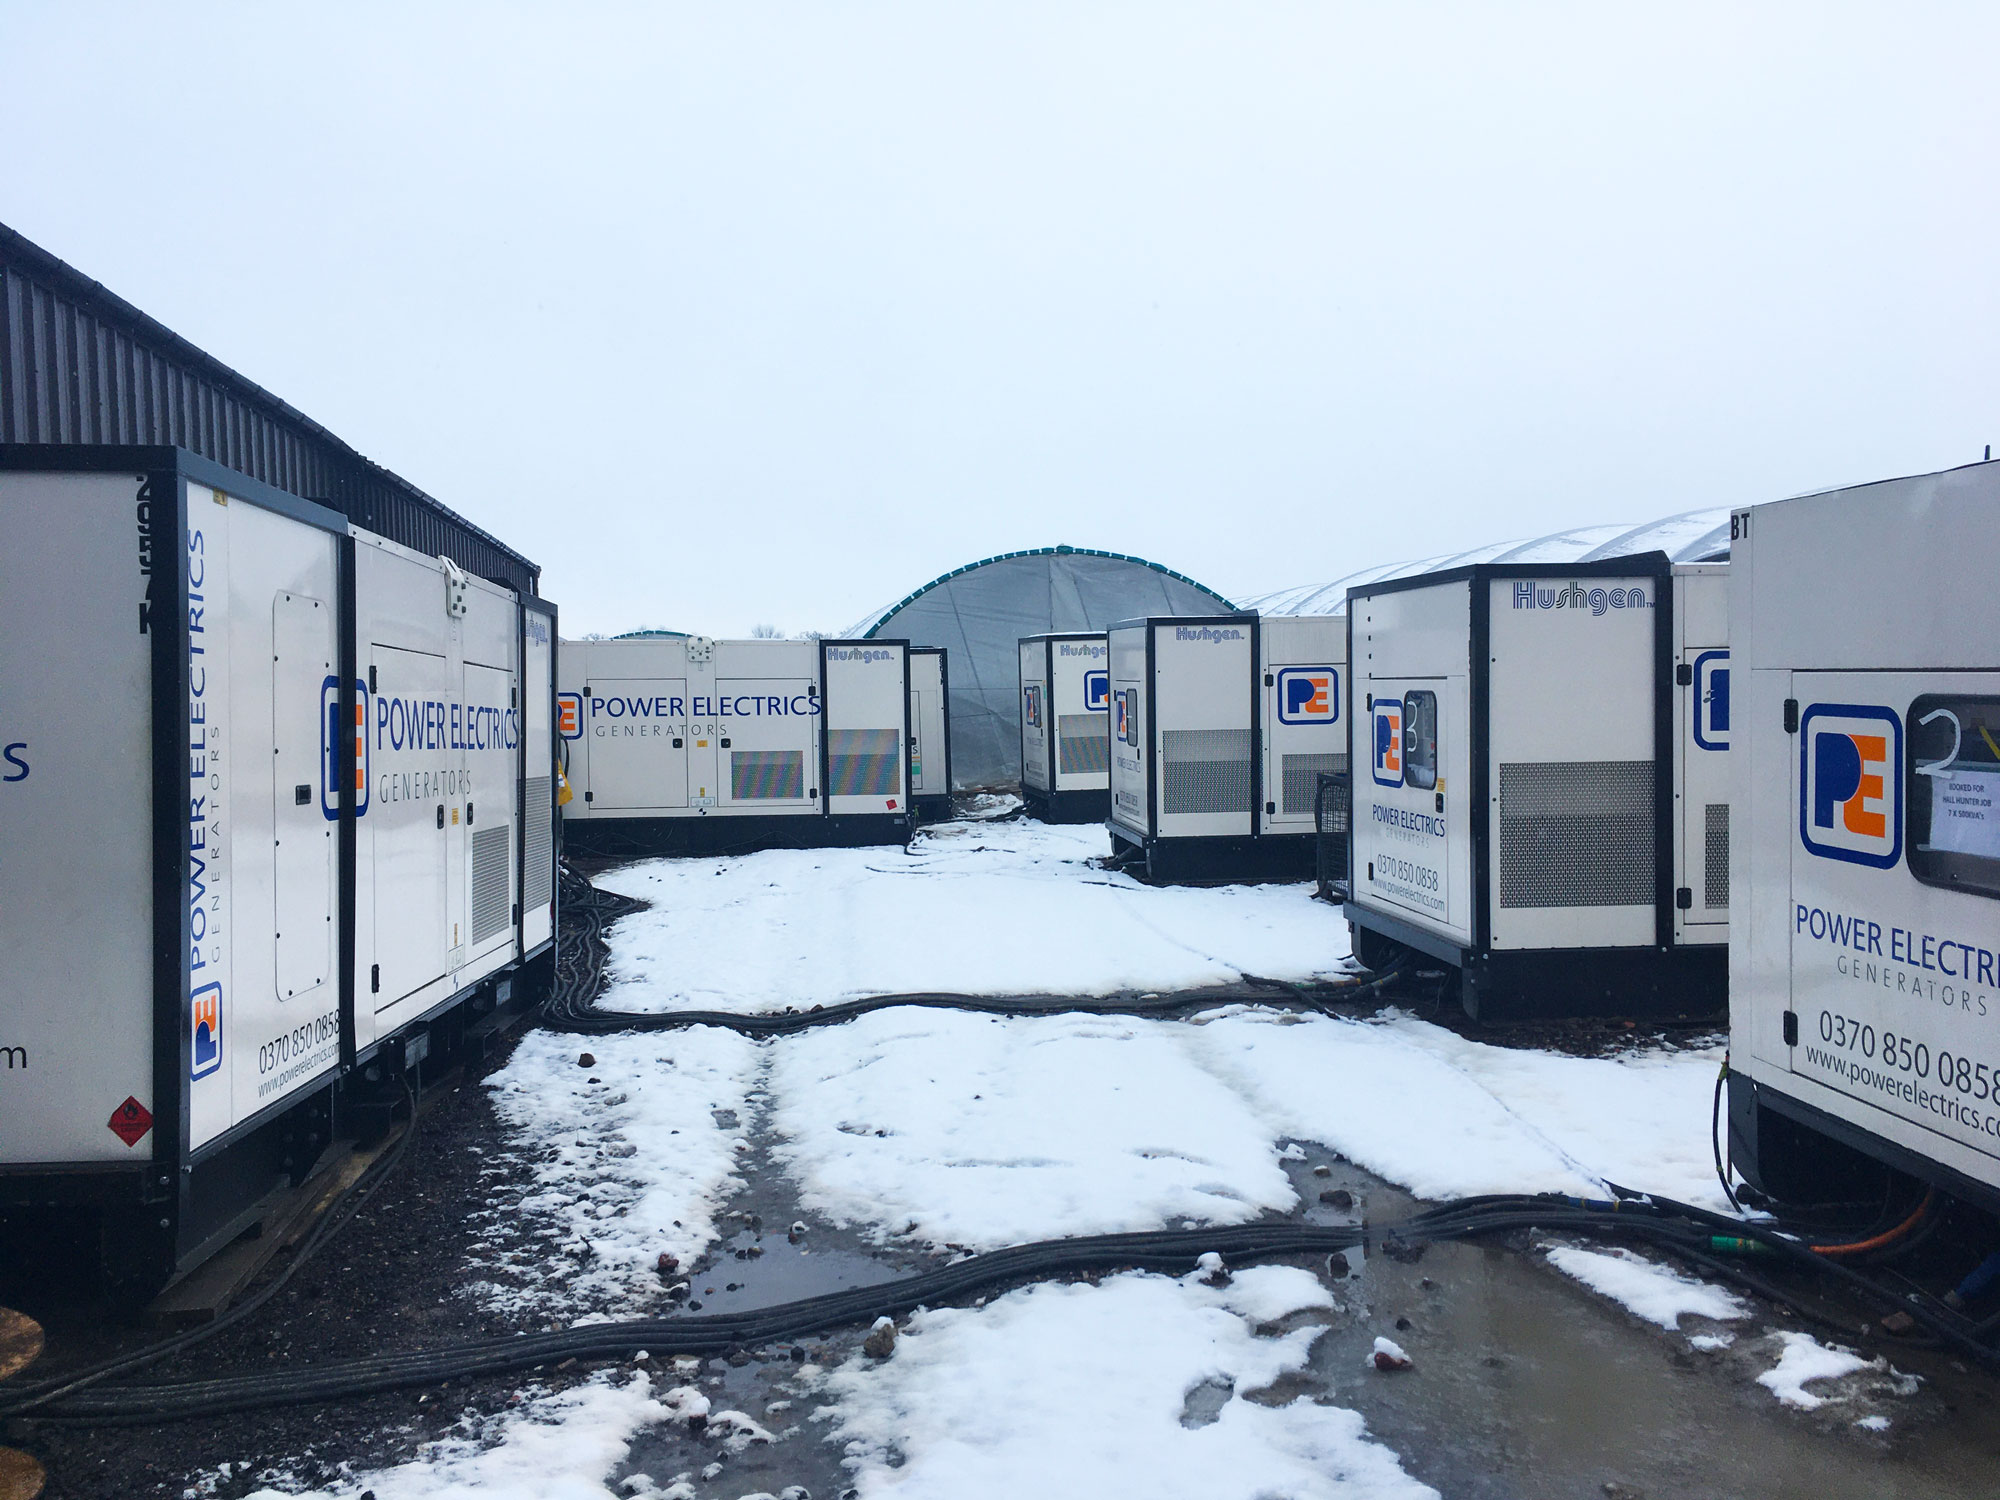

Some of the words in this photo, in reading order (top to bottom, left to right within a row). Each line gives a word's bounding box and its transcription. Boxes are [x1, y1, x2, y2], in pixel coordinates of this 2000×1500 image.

[1731, 513, 1750, 541] BT
[1513, 581, 1646, 616] Hushgen
[1060, 644, 1107, 659] Hushge
[1175, 626, 1241, 643] Hushgen
[188, 529, 206, 778] ELECTRICS
[827, 647, 890, 664] Hushgen
[592, 697, 684, 718] POWER
[693, 695, 822, 717] ELECTRICS
[1287, 678, 1329, 714] PE
[377, 697, 446, 751] POWER
[450, 702, 518, 750] ELECTRICS
[596, 723, 728, 737] GENERATORS
[1376, 714, 1400, 771] PE
[1406, 701, 1418, 752] 3
[1915, 708, 1961, 779] 2
[379, 769, 472, 804] GENERATORS
[1814, 731, 1886, 838] PE
[1949, 783, 1971, 792] BOOKED
[1973, 785, 1984, 793] FOR
[1980, 799, 1992, 807] JOB
[1373, 804, 1400, 827] POWER
[1401, 810, 1445, 838] ELECTRICS
[211, 726, 221, 964] GENERATORS
[190, 793, 206, 970] POWER
[1377, 853, 1397, 877] 0370
[1398, 860, 1414, 883] 850
[1416, 866, 1439, 892] 0858
[1373, 878, 1446, 912] www.powerelectrics.com
[1796, 904, 1883, 957] POWER
[1836, 955, 1988, 1017] GENERATORS
[260, 1034, 290, 1074] 0370
[292, 1022, 313, 1057] 850
[315, 1008, 340, 1044] 0858
[1820, 1010, 1875, 1058] 0370
[1882, 1032, 1930, 1079] 850
